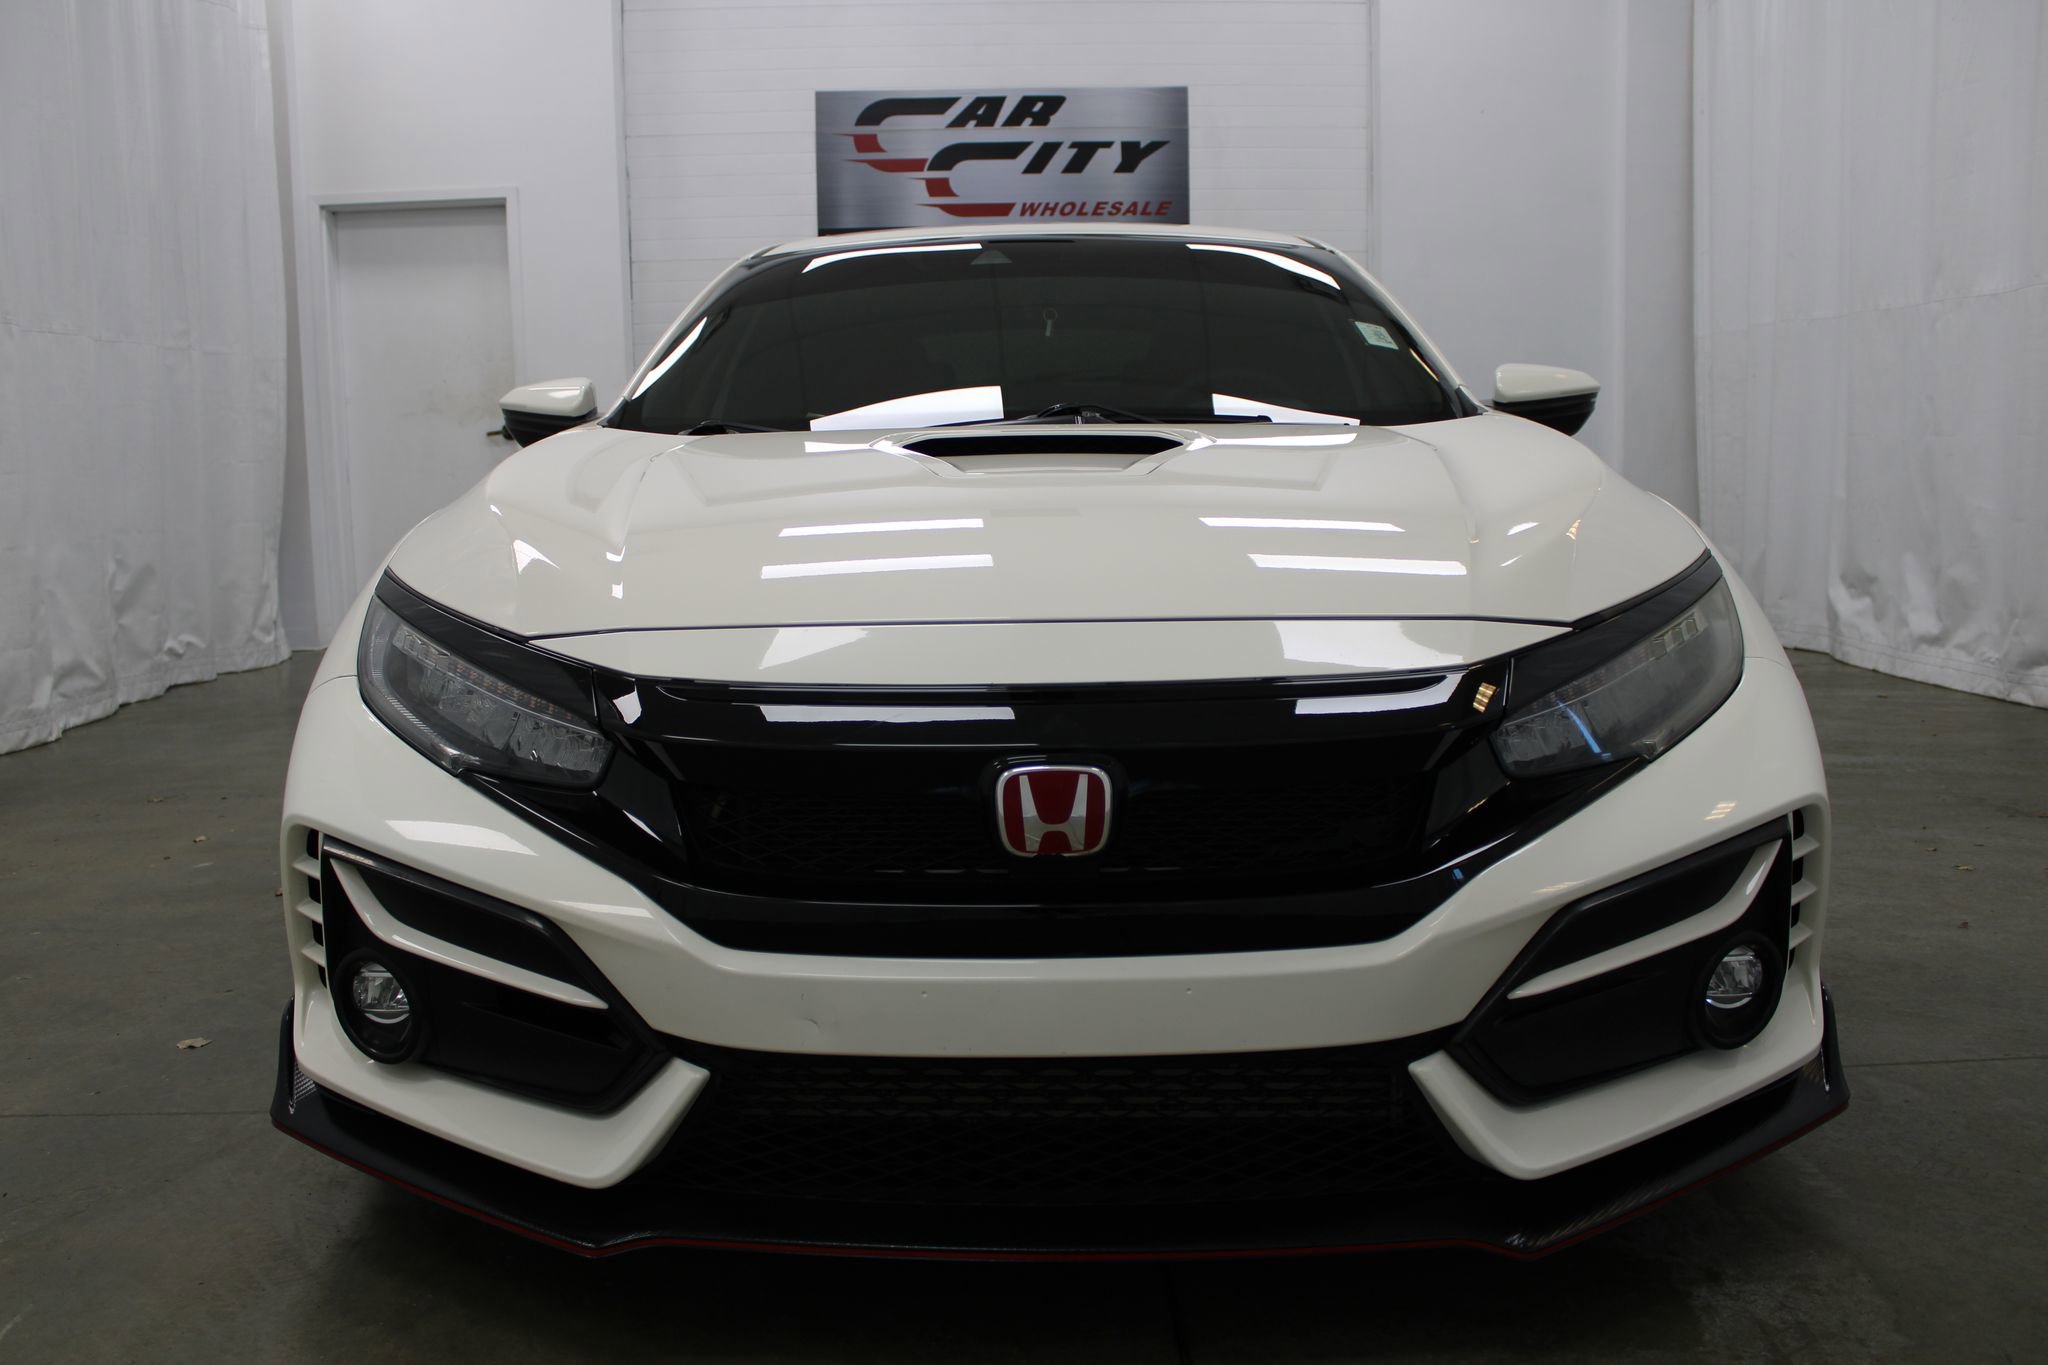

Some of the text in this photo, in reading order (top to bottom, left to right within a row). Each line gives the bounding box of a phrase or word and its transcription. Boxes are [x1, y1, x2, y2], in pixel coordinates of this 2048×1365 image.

[833, 95, 1066, 172] CAR
[908, 141, 1171, 217] CITY
[1019, 201, 1173, 217] WHOLESALE
